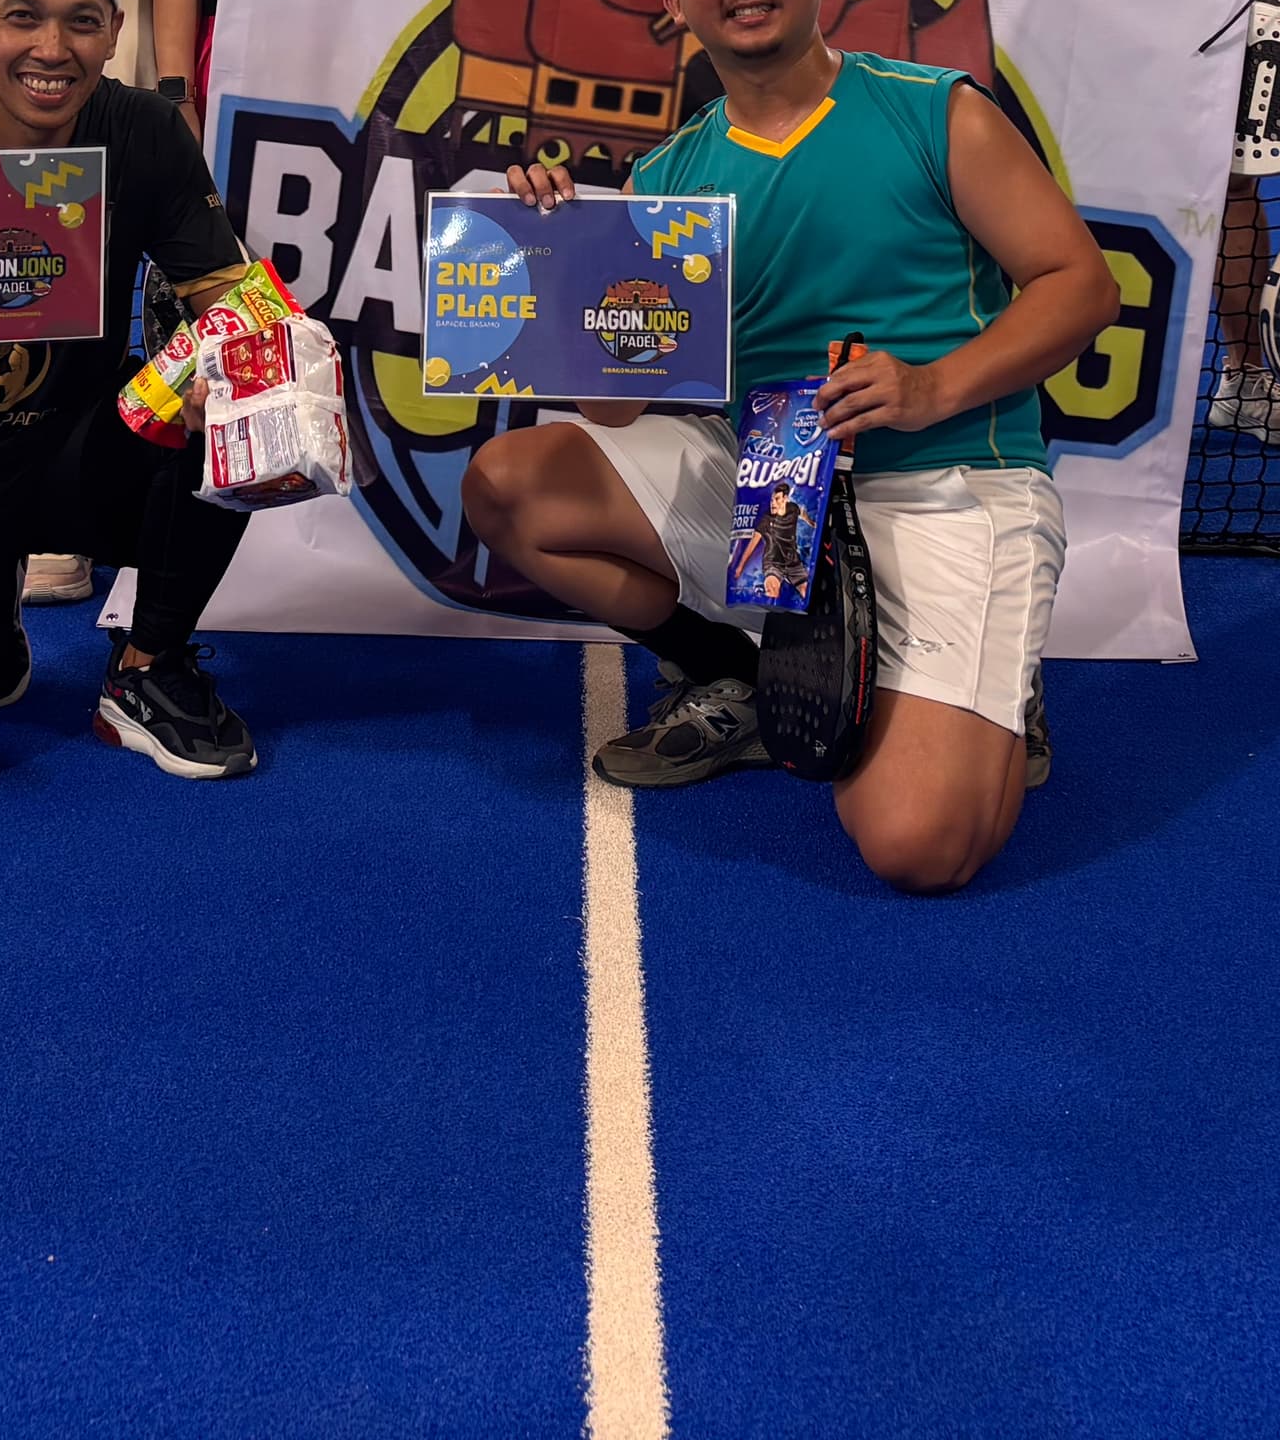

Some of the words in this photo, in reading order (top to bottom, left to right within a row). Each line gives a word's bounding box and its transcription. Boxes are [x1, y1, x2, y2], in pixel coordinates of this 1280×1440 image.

[436, 262, 501, 287] 2ND
[436, 293, 537, 319] PLACE
[583, 308, 690, 332] BAGONJONG
[619, 334, 658, 349] PADEL
[736, 449, 823, 489] ewangi
